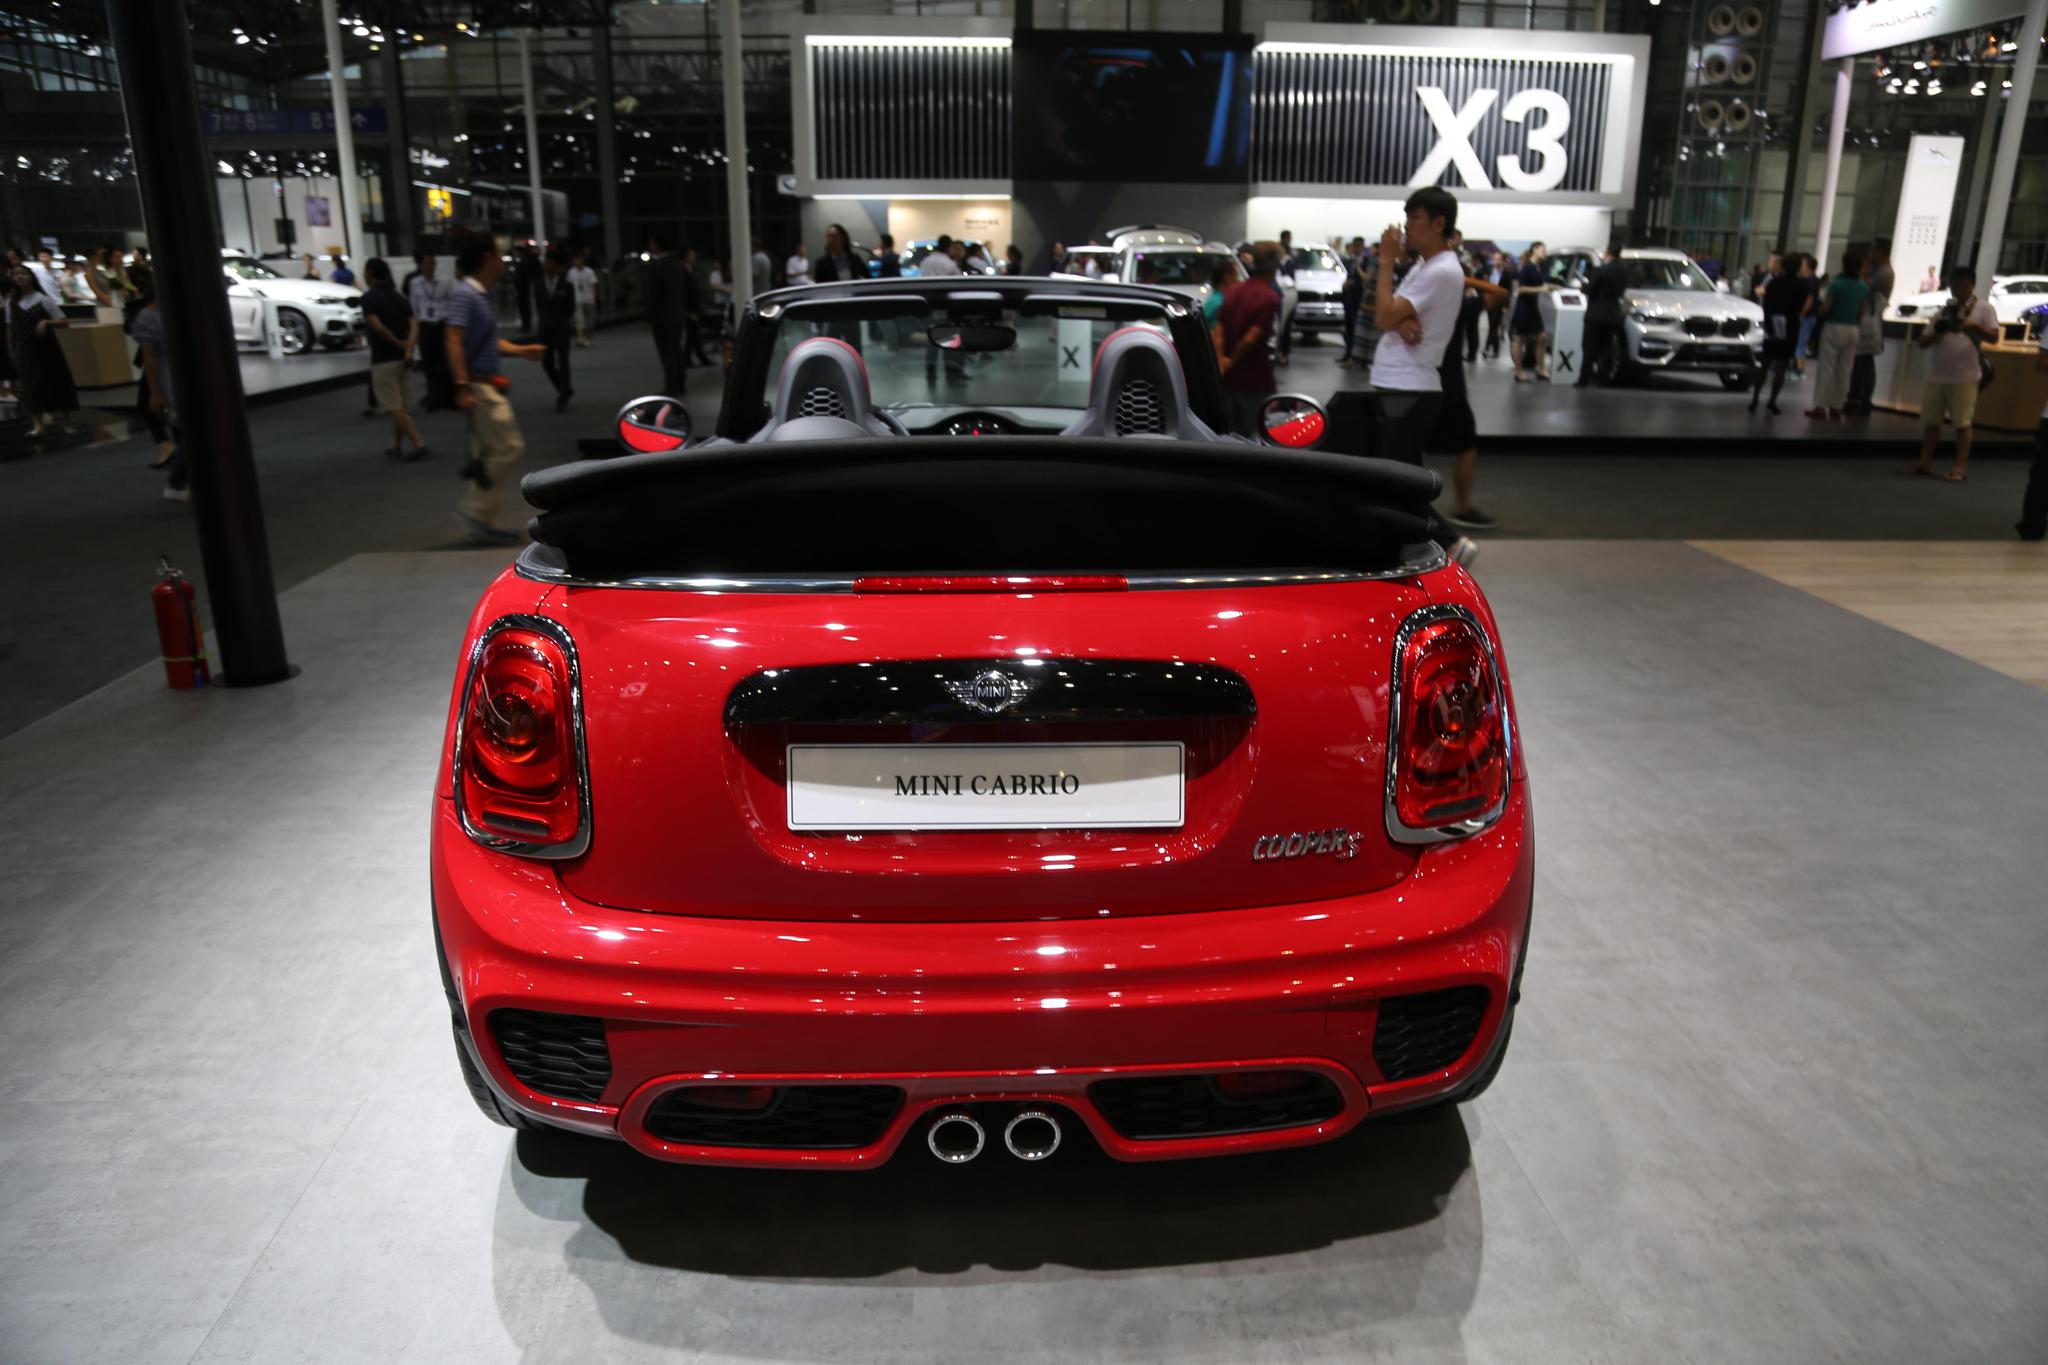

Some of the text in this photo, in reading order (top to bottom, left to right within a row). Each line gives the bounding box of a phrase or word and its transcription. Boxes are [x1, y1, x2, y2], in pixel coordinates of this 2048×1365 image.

[1407, 86, 1571, 192] X3
[1062, 345, 1080, 368] X
[1556, 350, 1575, 372] X
[977, 686, 1006, 698] MINI
[894, 774, 1080, 796] MINI CABRIO
[1253, 828, 1347, 860] COOPER
